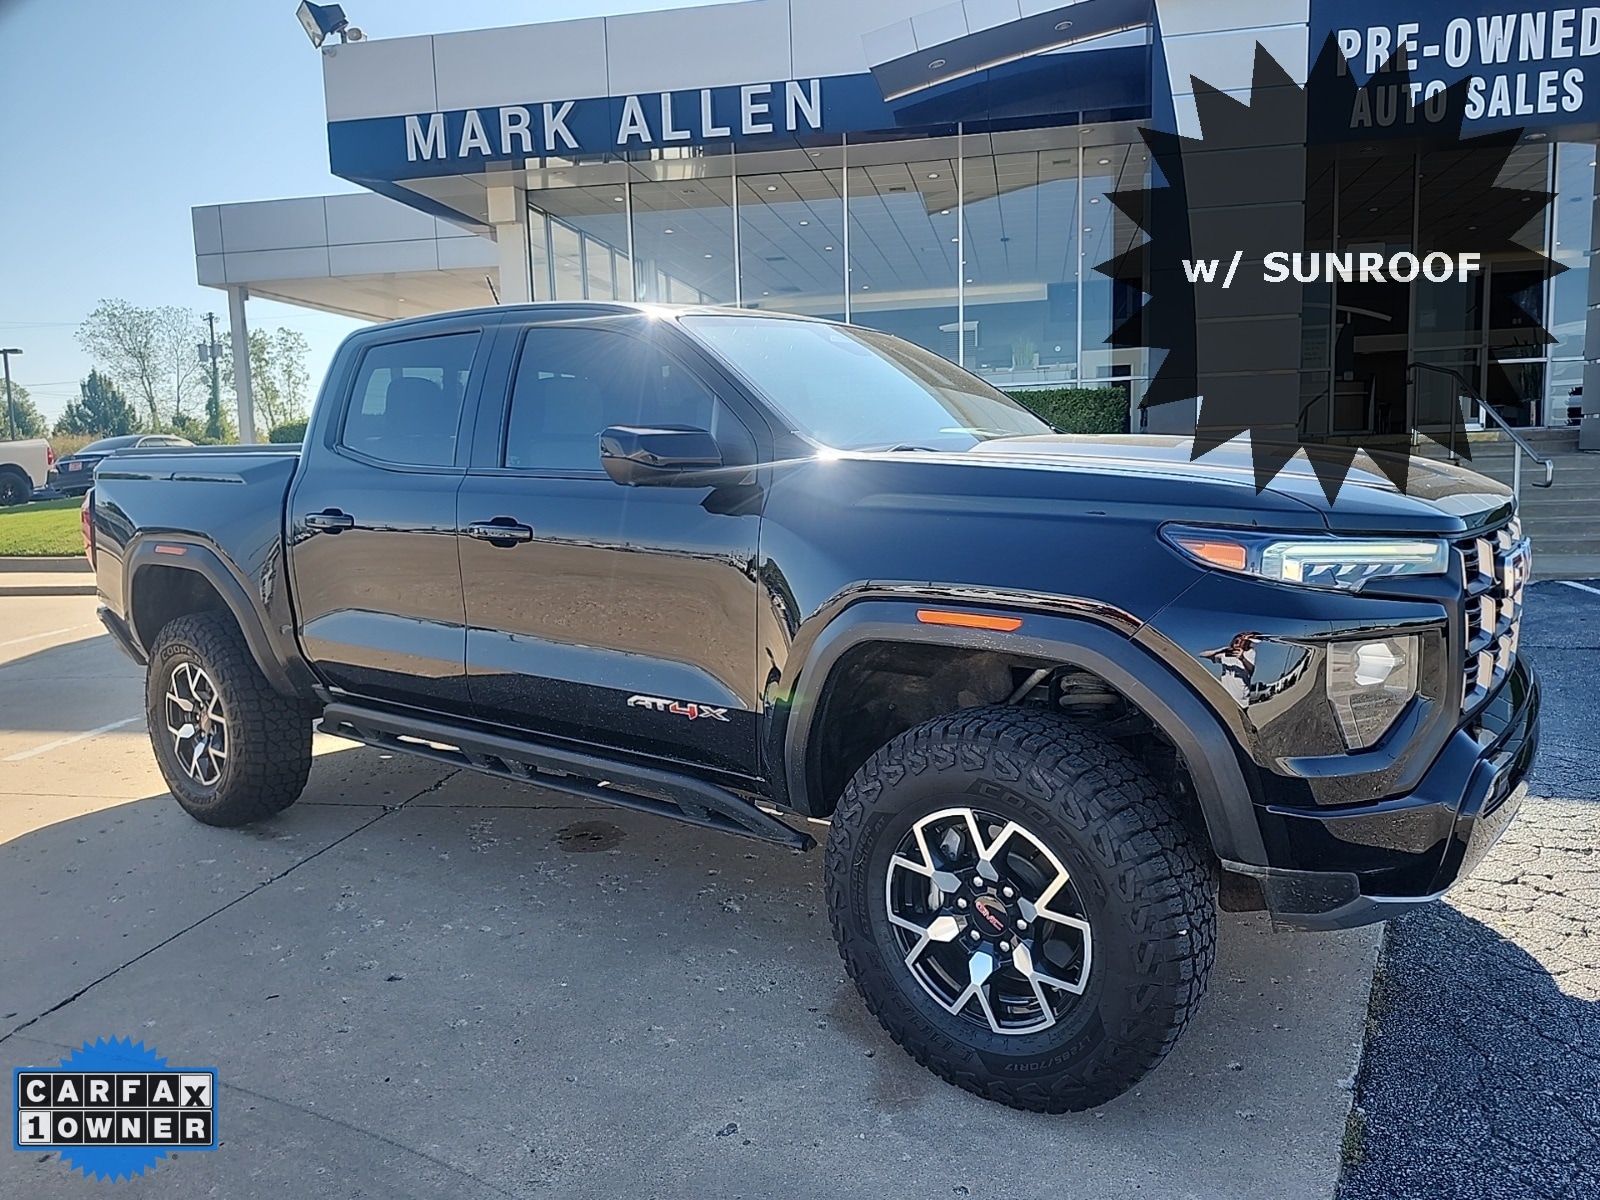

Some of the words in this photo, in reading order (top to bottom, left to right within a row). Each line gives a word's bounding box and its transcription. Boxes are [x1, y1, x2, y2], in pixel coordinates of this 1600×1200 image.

[1336, 6, 1600, 77] PRE-OWNED
[404, 100, 579, 162] MARK
[616, 79, 821, 145] ALLEN
[1349, 79, 1448, 129] AUTO
[1464, 67, 1585, 120] SALES
[626, 694, 731, 722] AT4X
[975, 900, 1004, 931] GMC
[1003, 1034, 1093, 1072] LT285/70R17
